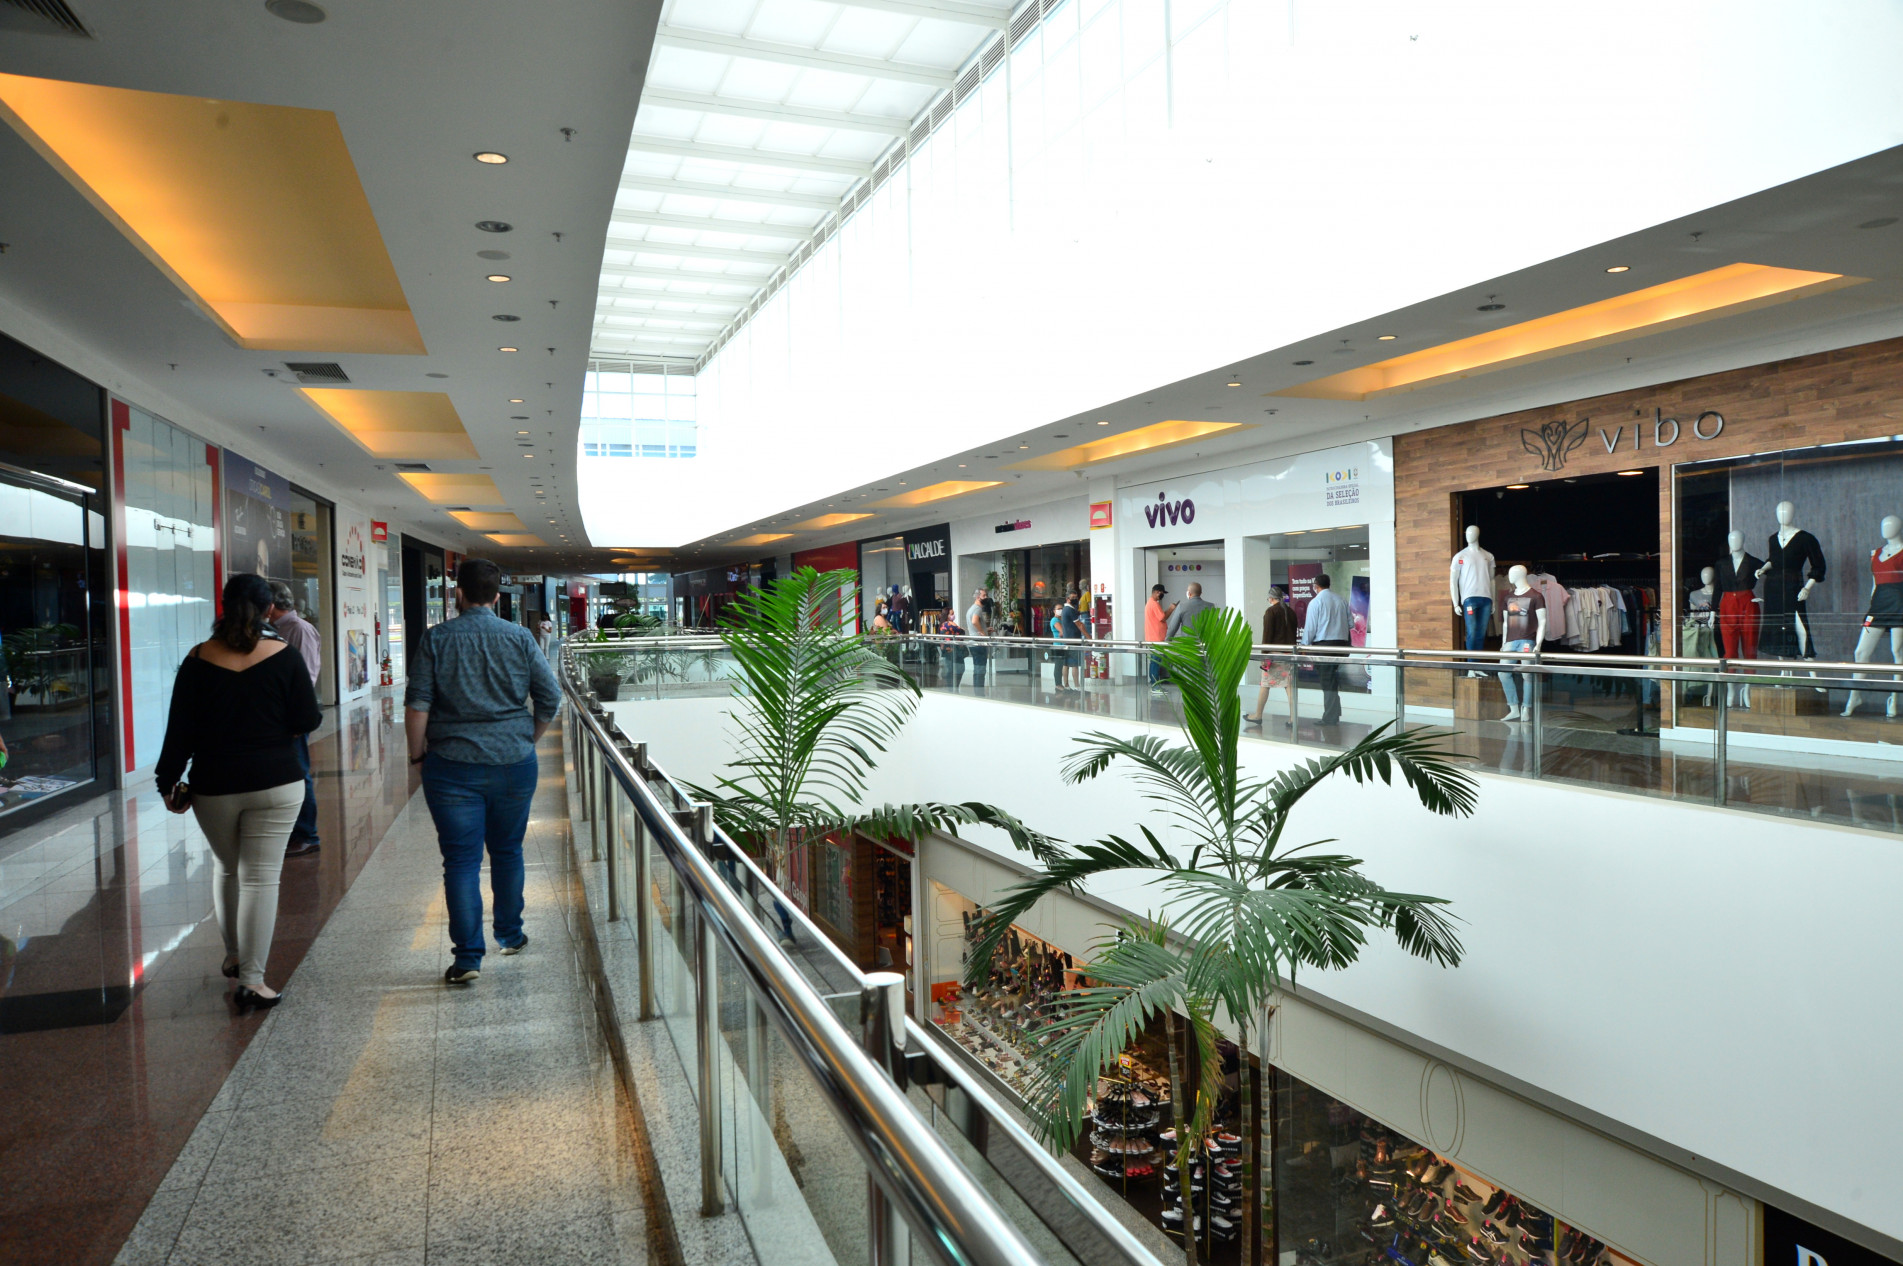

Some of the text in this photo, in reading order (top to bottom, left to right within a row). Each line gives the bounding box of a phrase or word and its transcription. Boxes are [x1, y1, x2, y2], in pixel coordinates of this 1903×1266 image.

[1600, 408, 1724, 454] vibo
[1326, 488, 1360, 500] DA SELEÇÃO
[1335, 498, 1360, 506] BRASILEIROS
[1144, 491, 1196, 529] vivo
